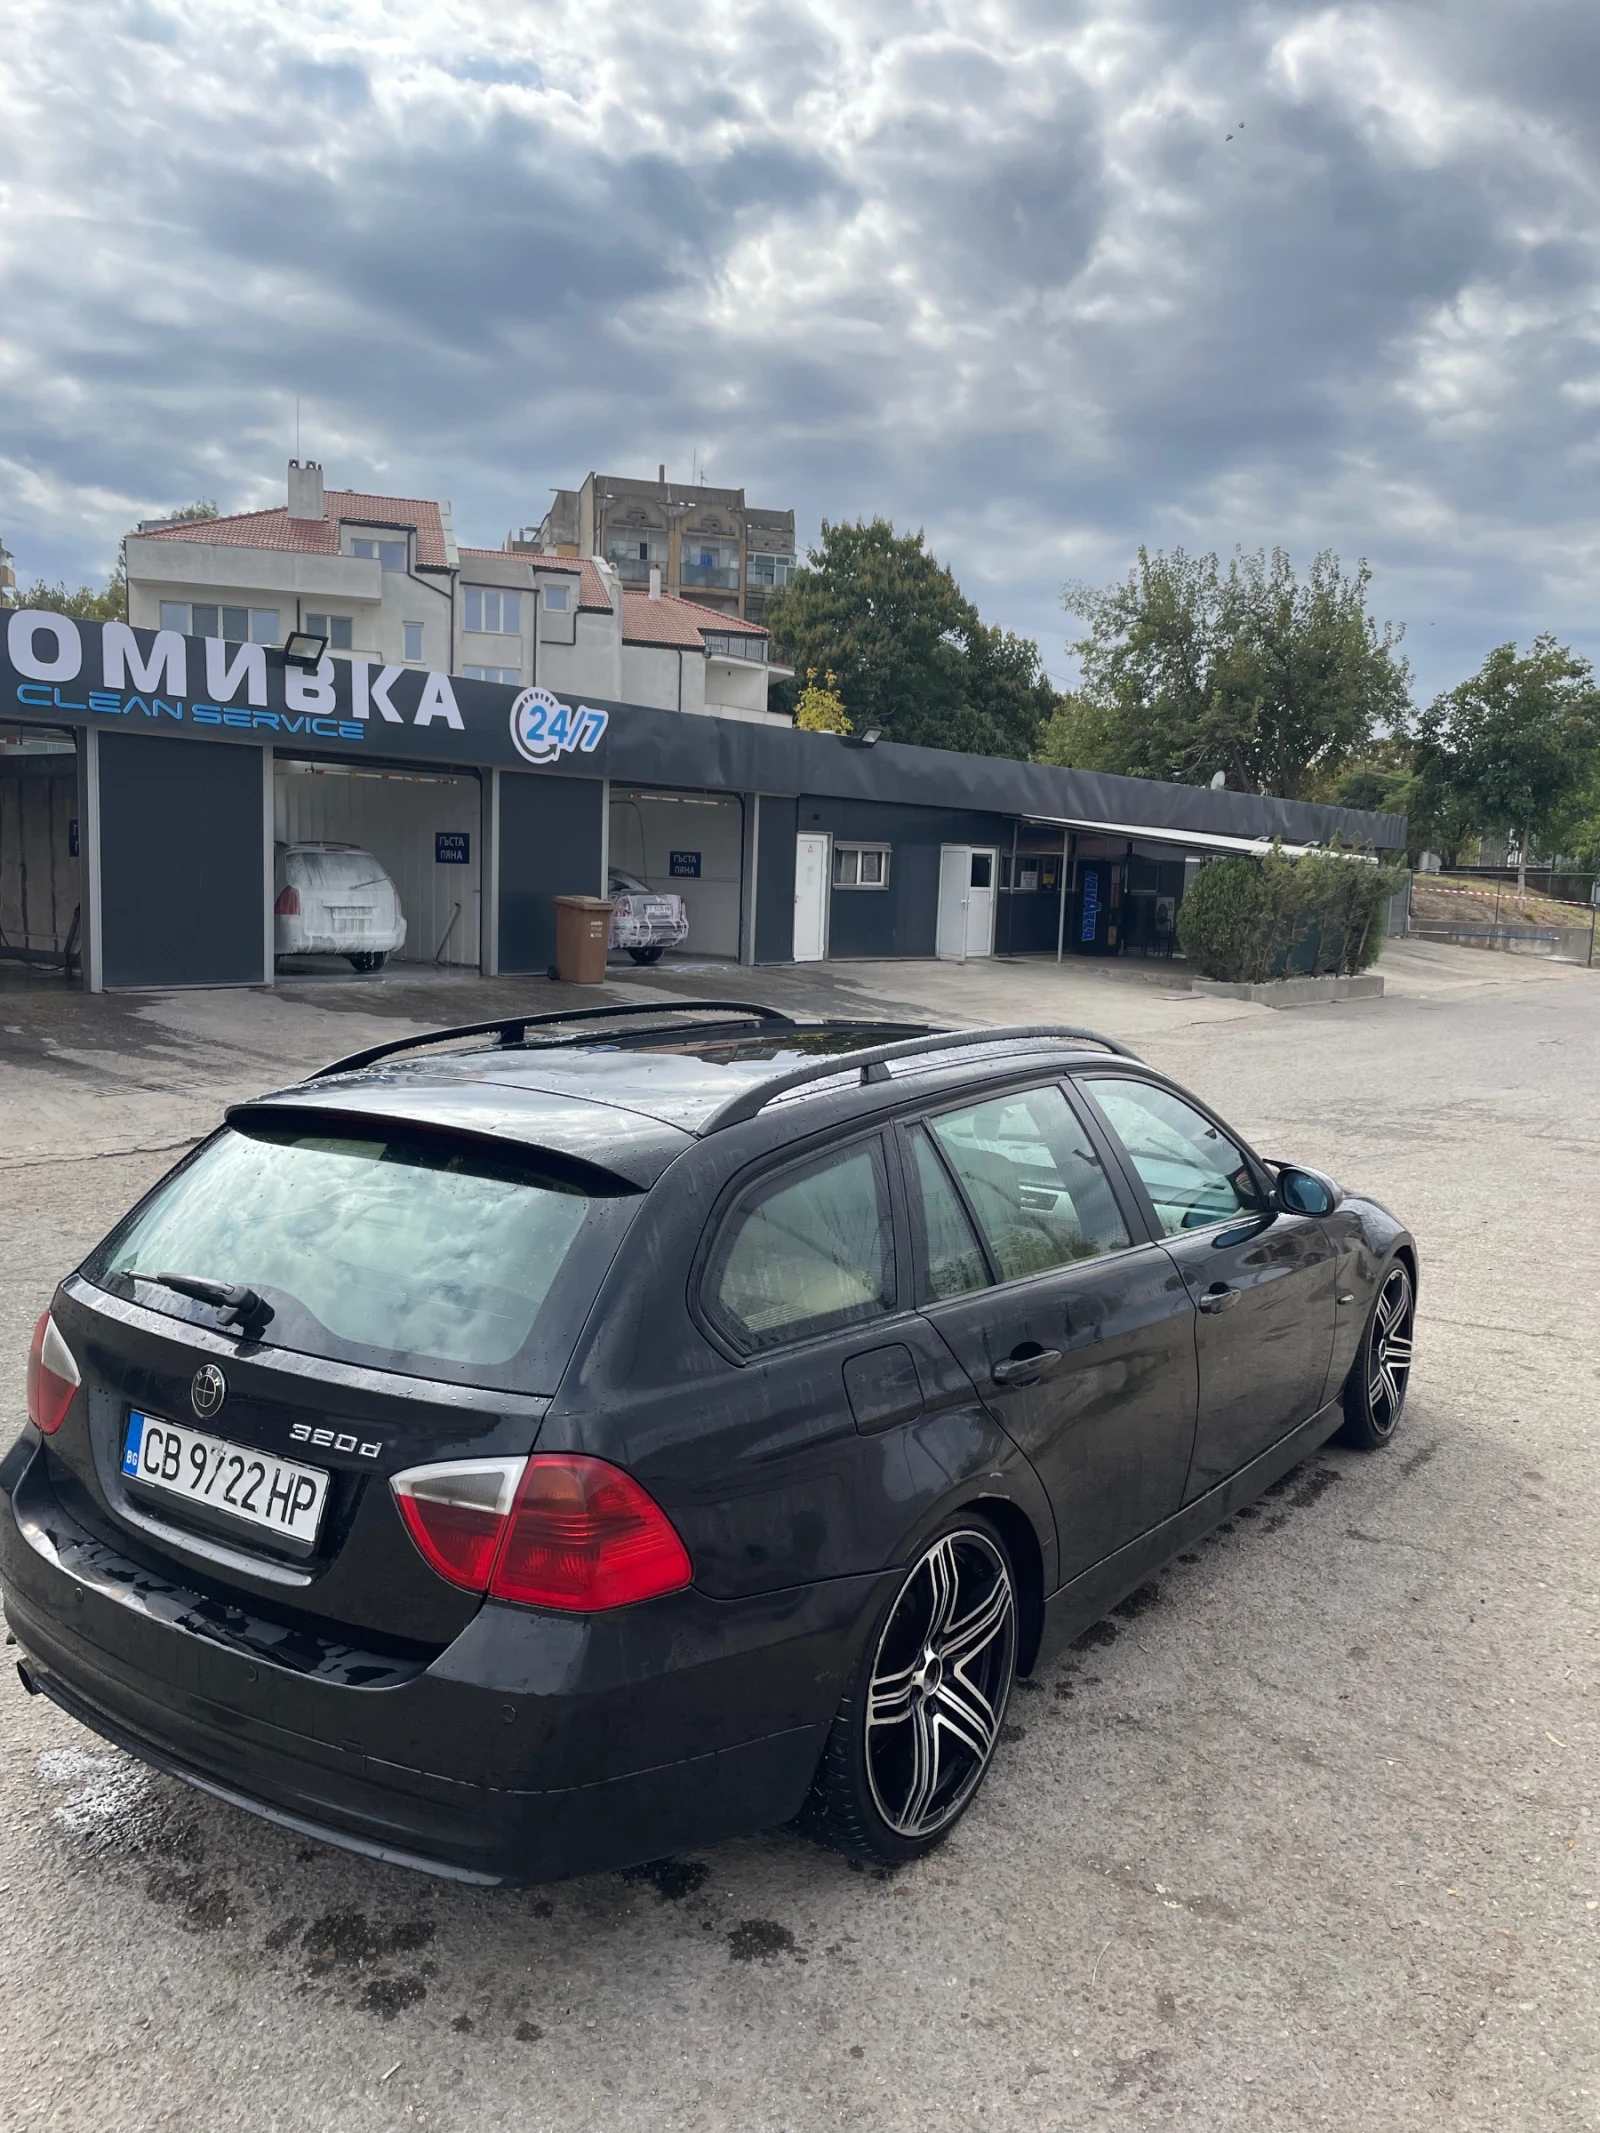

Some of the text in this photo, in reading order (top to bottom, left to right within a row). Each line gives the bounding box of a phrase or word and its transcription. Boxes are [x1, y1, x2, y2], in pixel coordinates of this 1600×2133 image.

[17, 684, 364, 740] CLEAN SERVICE
[526, 704, 605, 747] 24/7
[440, 850, 463, 861] ПЯНА
[674, 865, 695, 875] ПЯНА
[1082, 871, 1101, 941] LAVAZZA
[126, 1450, 138, 1466] BG
[289, 1424, 382, 1458] 320d
[266, 1468, 316, 1525] HP
